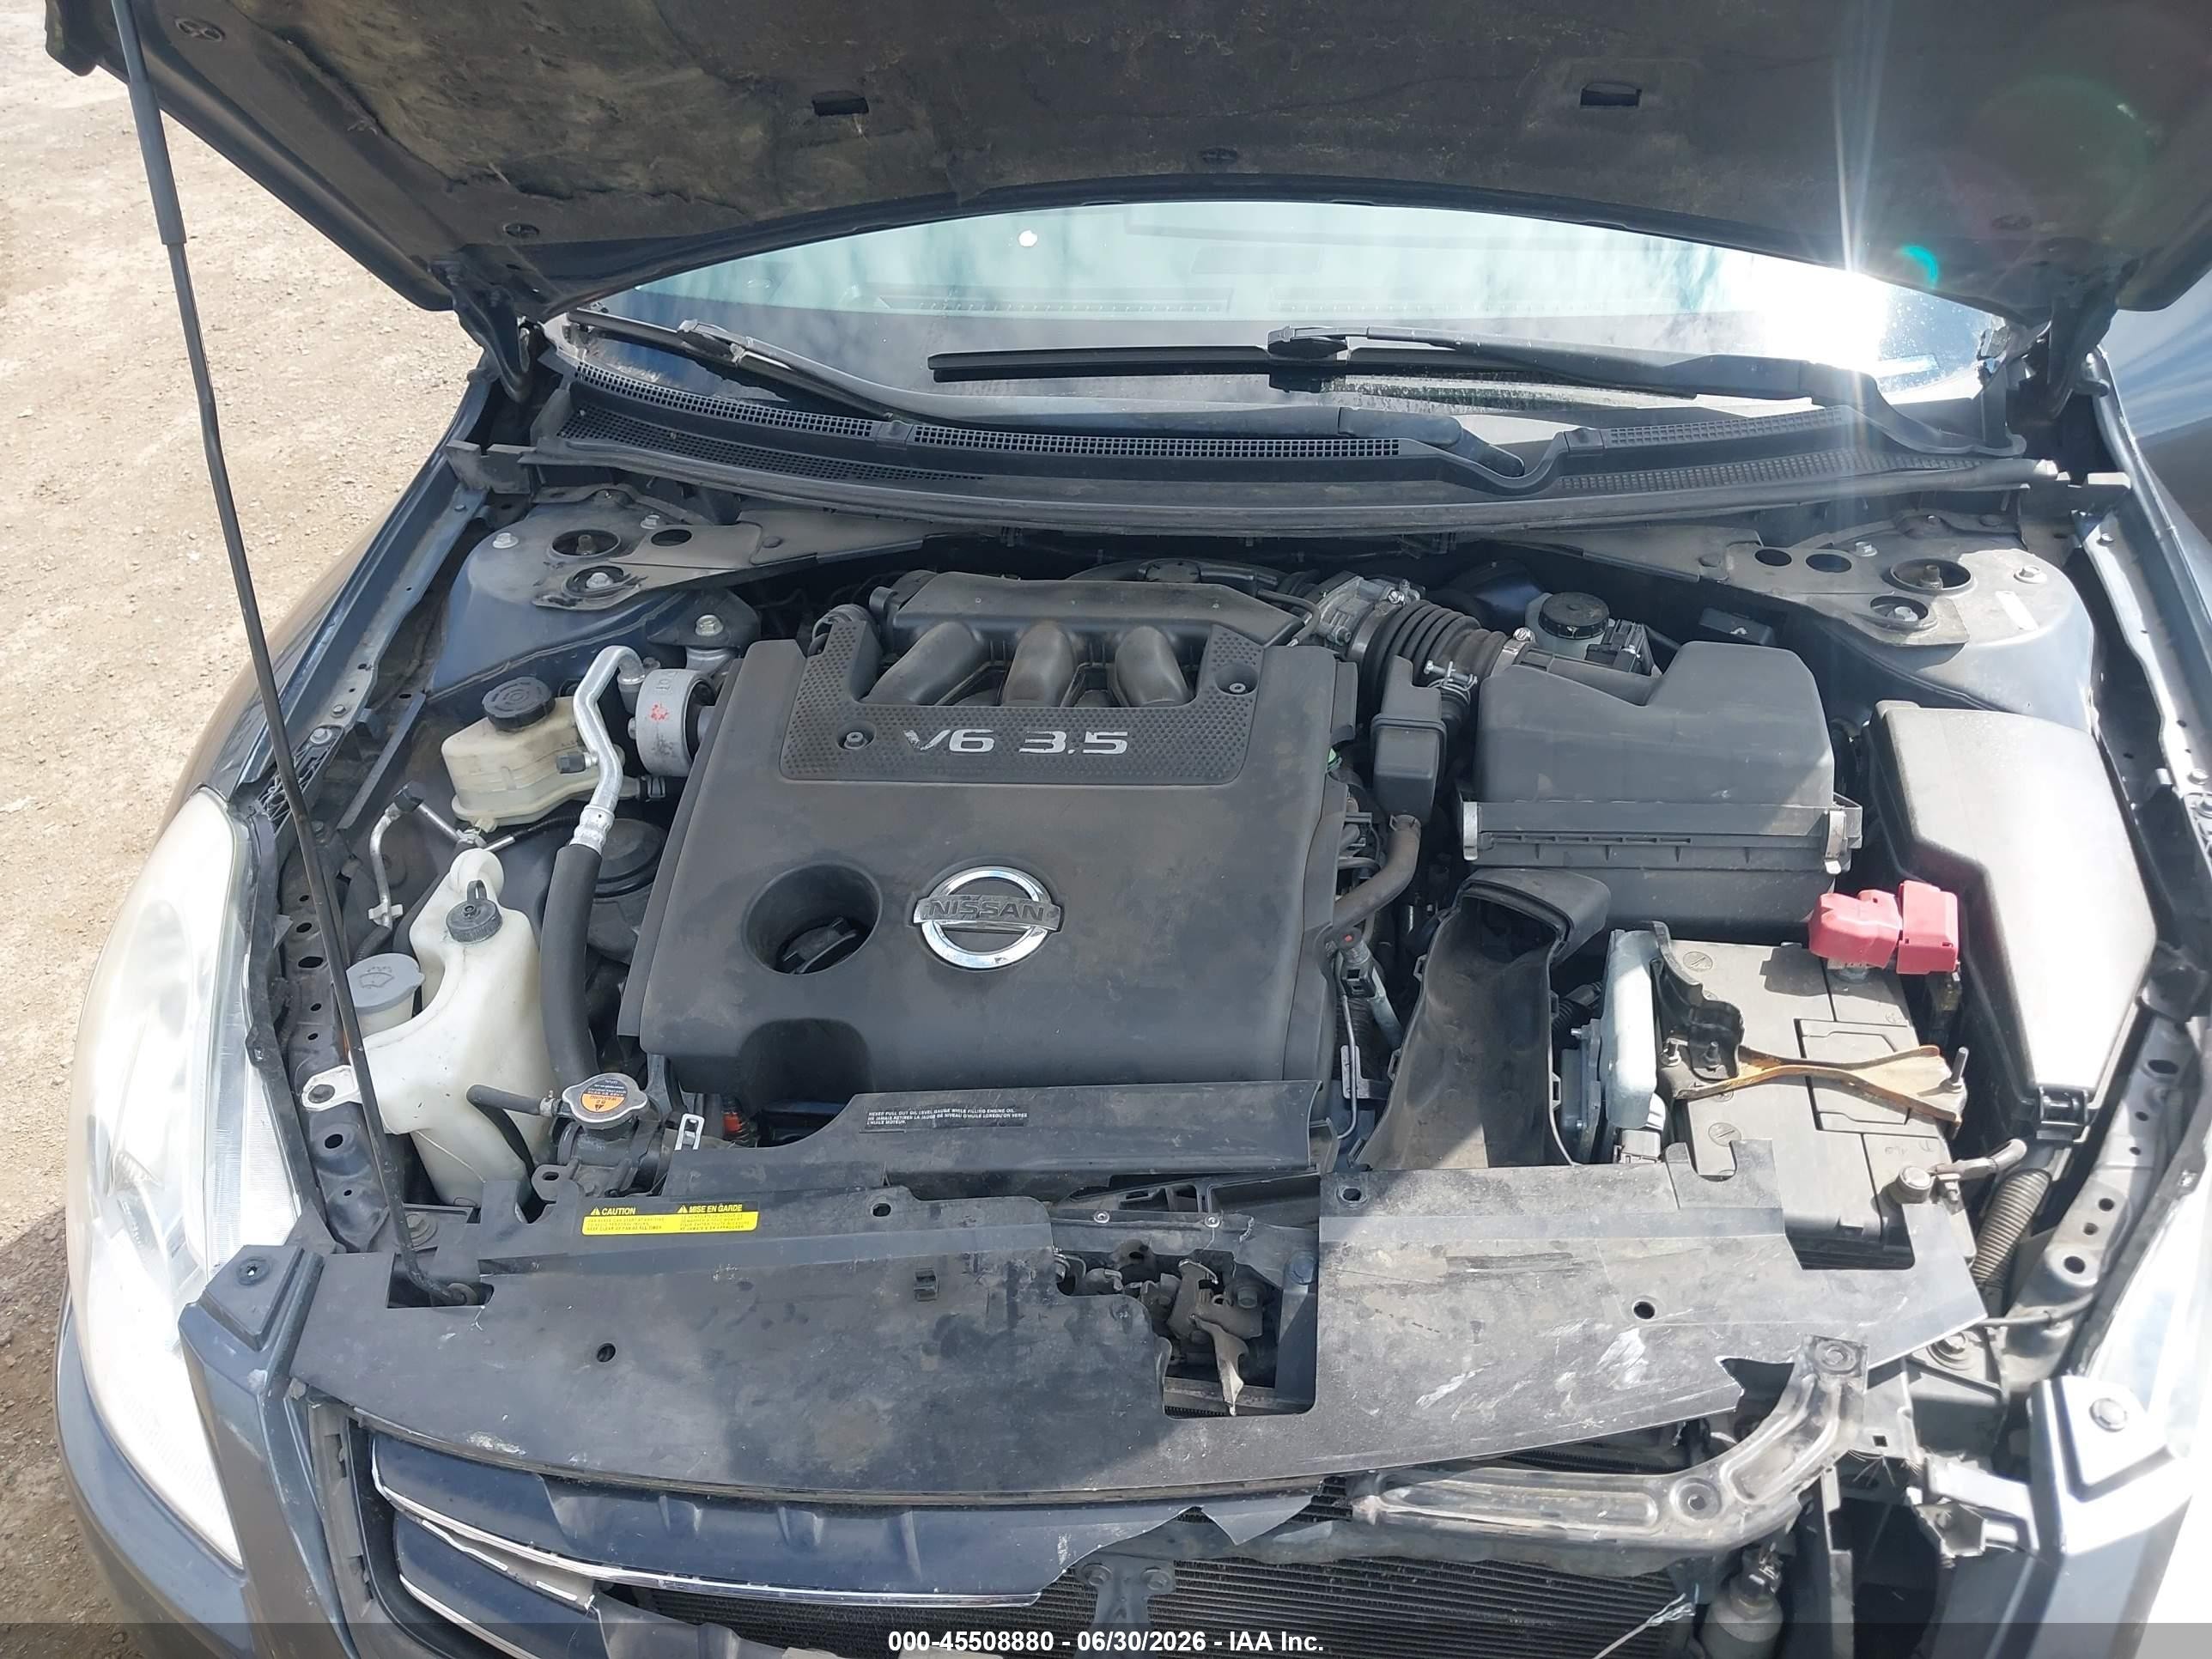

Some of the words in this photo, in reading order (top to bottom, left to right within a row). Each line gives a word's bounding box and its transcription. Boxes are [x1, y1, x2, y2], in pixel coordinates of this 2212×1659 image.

[902, 728, 995, 753] V6
[1018, 730, 1129, 756] 3.5
[928, 899, 1044, 921] NISSAN
[601, 1207, 635, 1216] CAUTION
